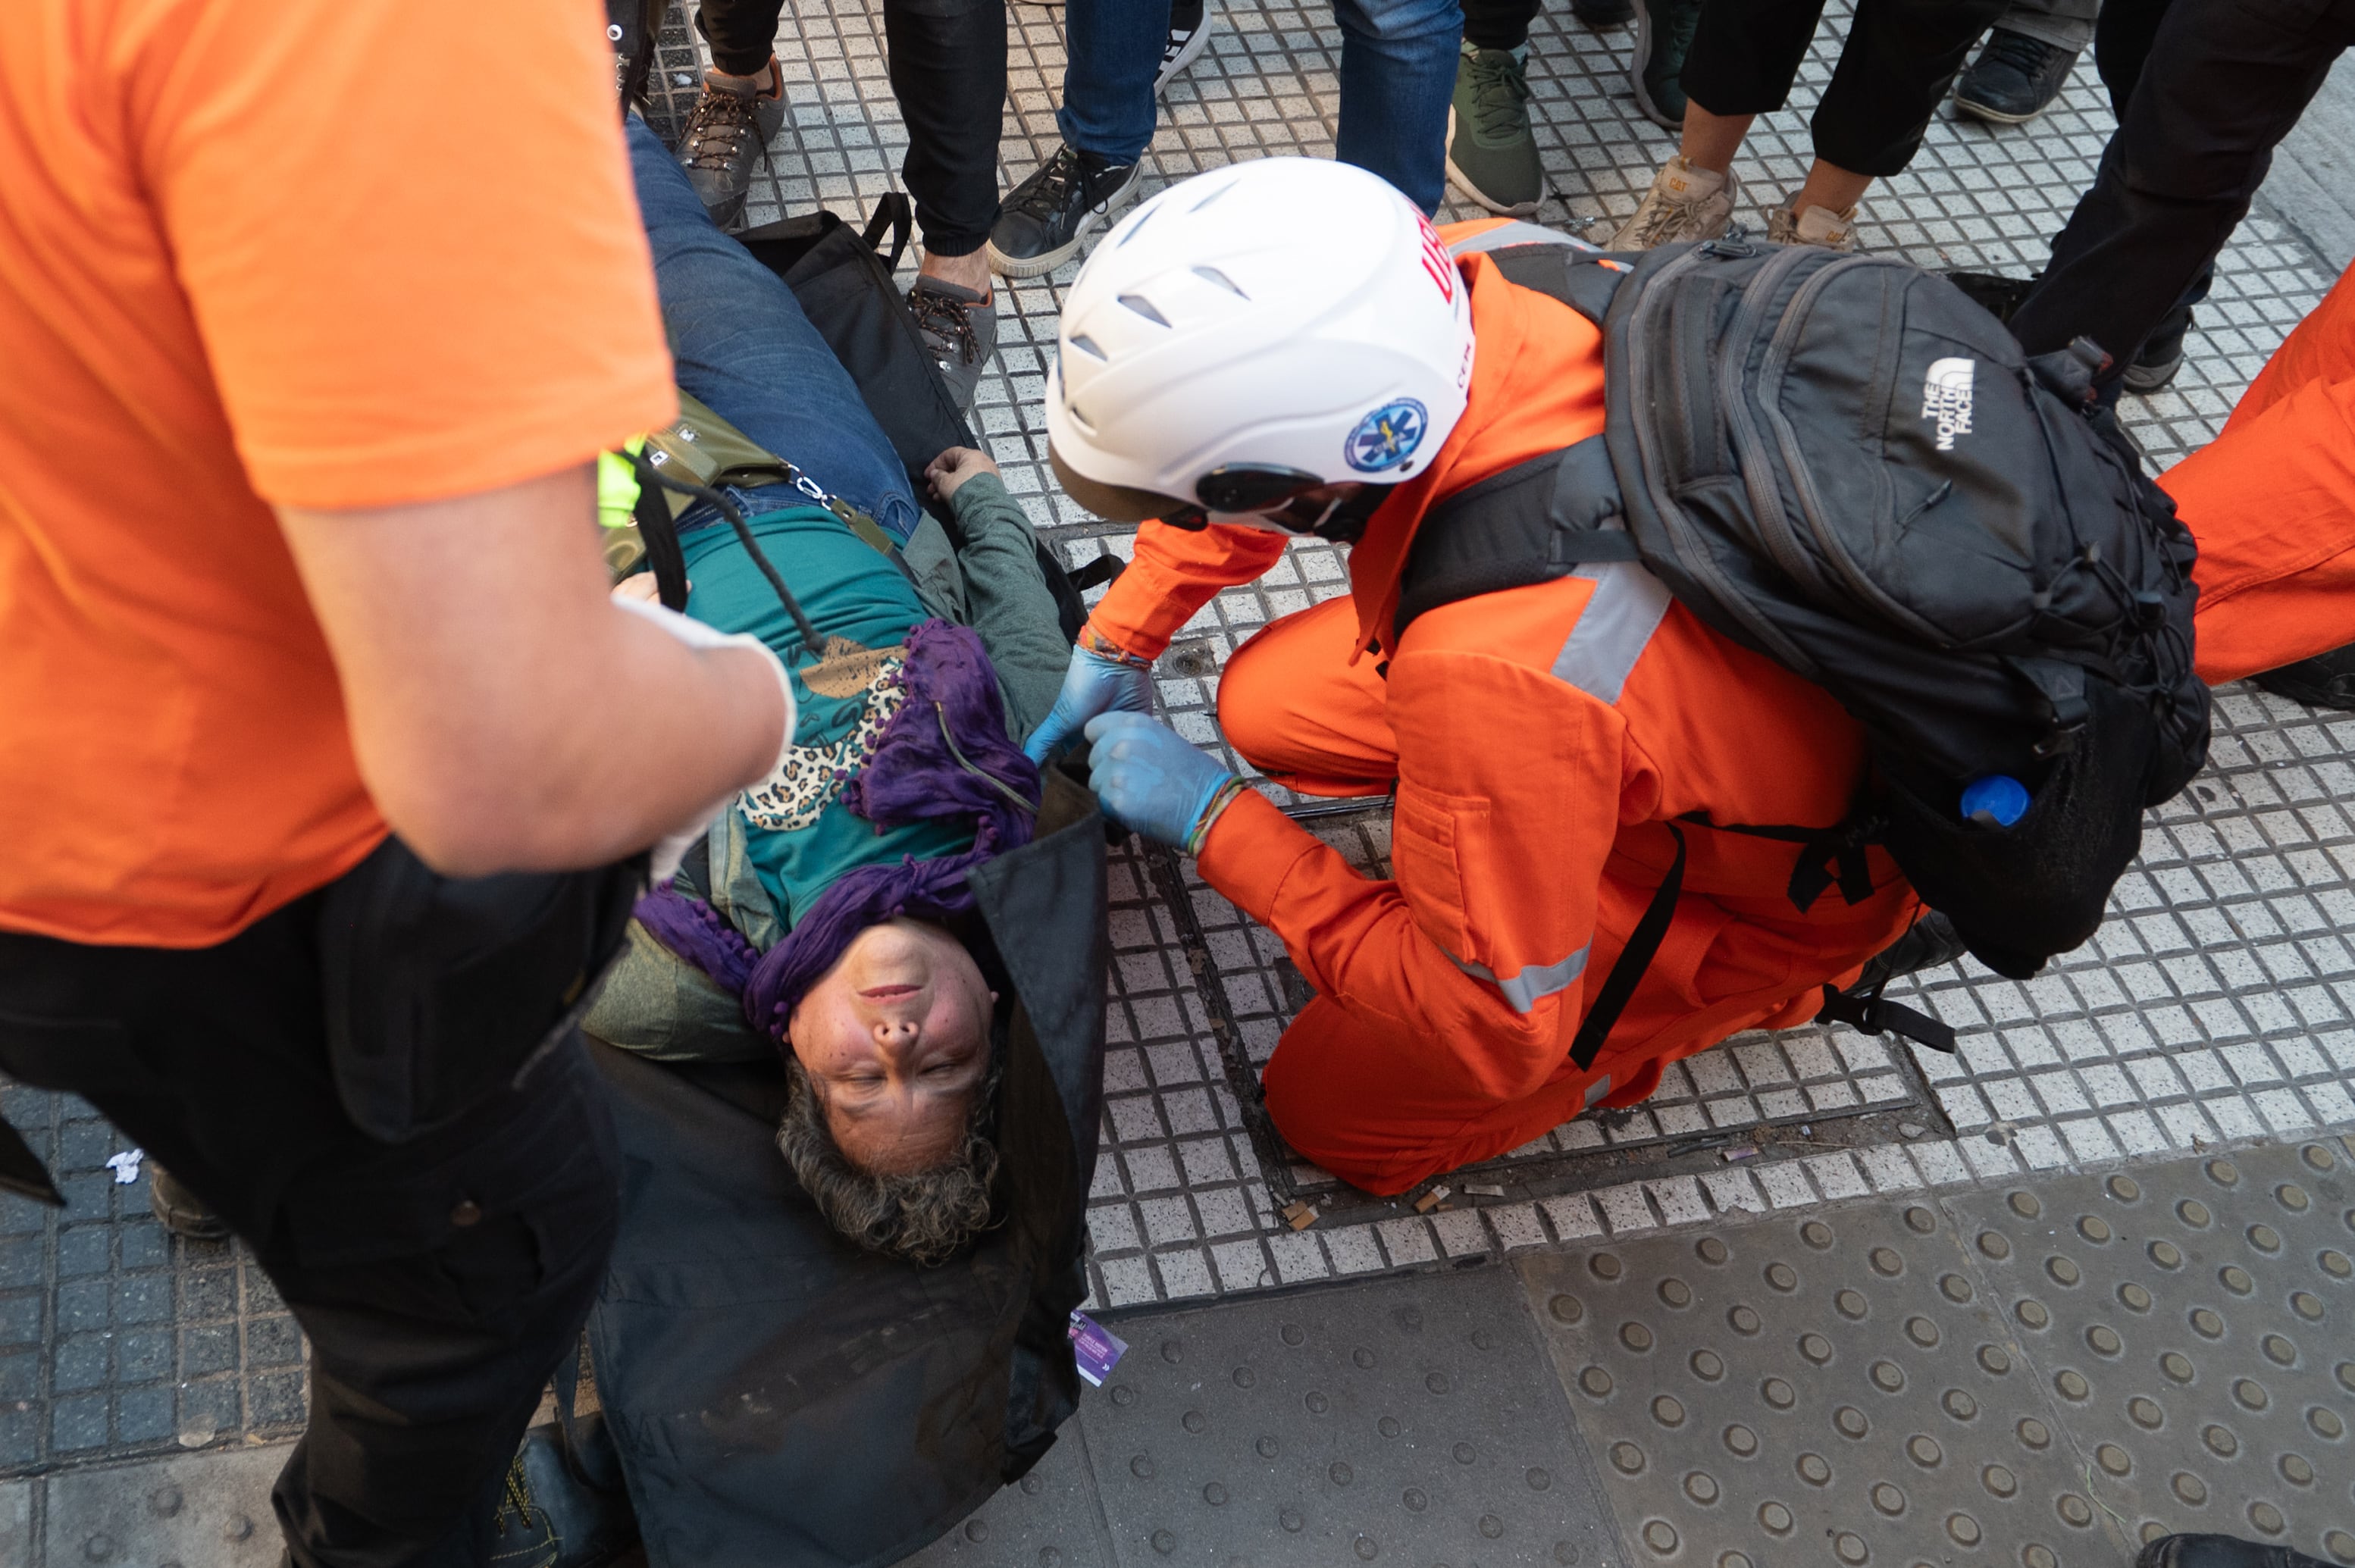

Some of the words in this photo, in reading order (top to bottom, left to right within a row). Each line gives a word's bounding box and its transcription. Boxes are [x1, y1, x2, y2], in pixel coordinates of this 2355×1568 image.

[1669, 177, 1688, 192] CAT
[1921, 382, 1940, 419] THE
[1935, 387, 1956, 450] NORTH
[1955, 388, 1973, 433] FACE
